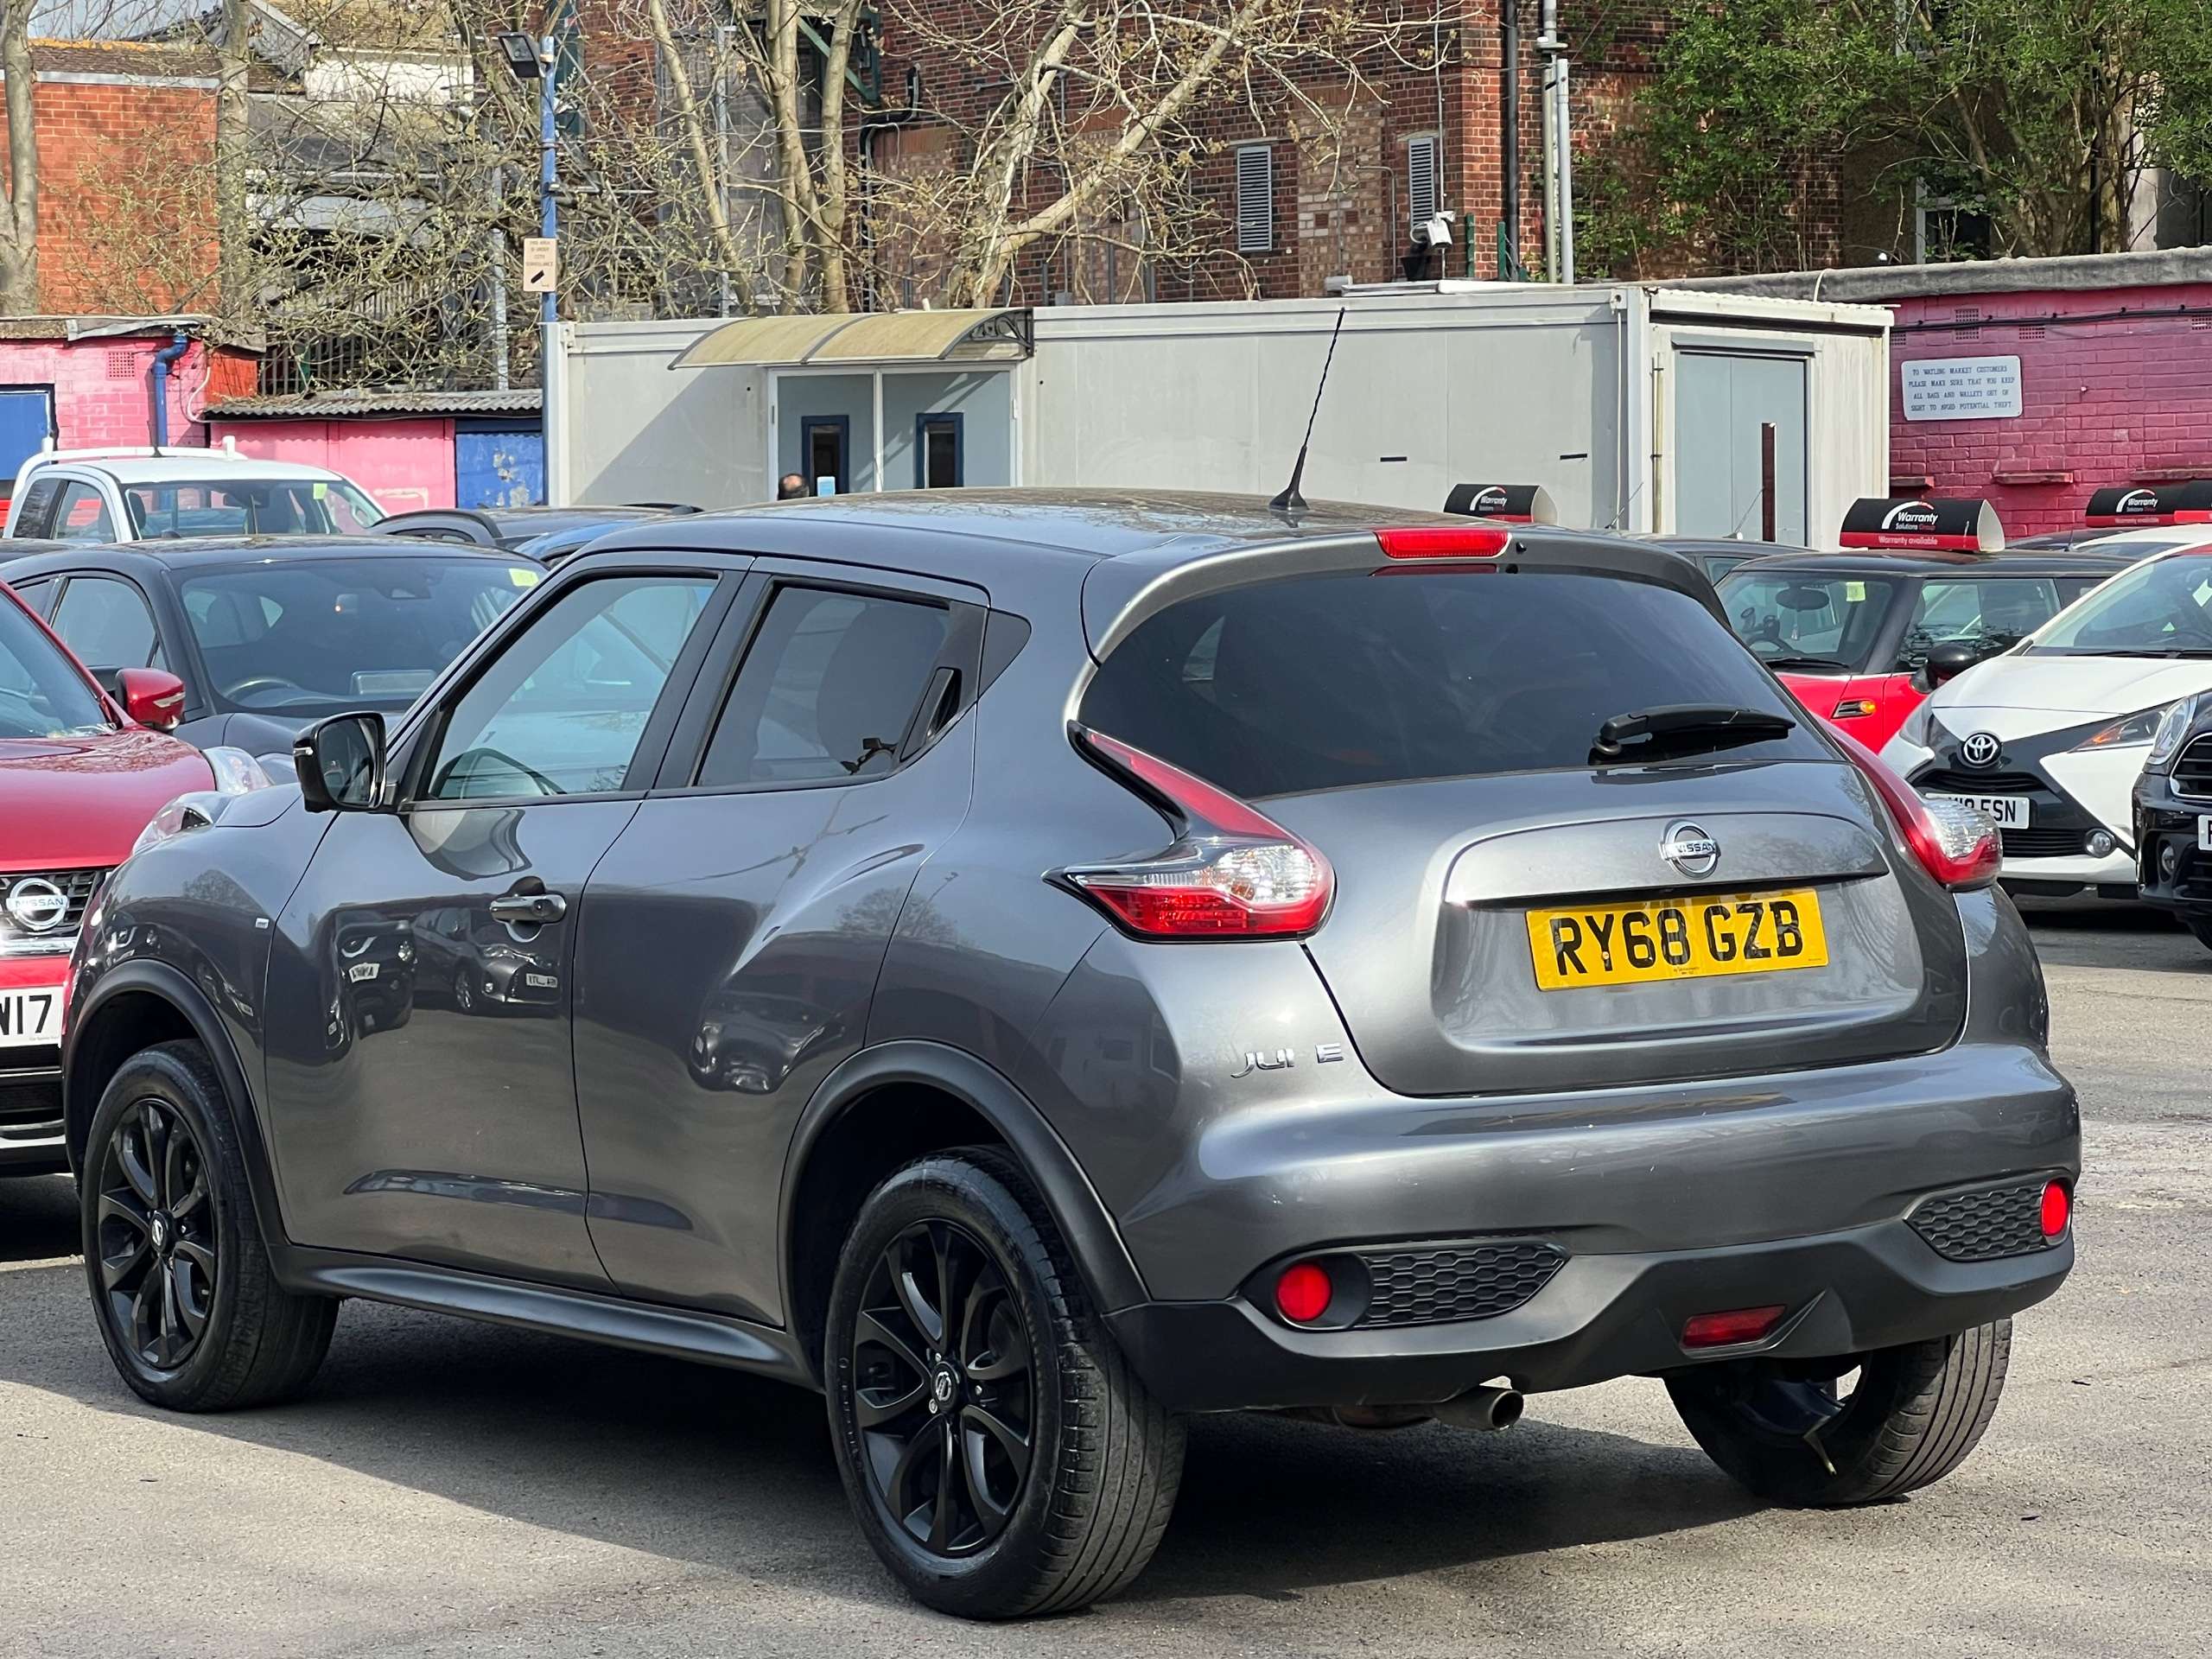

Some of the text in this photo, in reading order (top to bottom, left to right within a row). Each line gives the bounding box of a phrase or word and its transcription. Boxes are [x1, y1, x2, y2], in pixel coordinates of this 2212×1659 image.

[2127, 498, 2158, 508] Warranty
[1897, 512, 1939, 525] Warranty
[1878, 535, 1938, 545] Warranty available
[1675, 842, 1716, 854] NISSAN
[15, 898, 64, 908] NISSAN
[1549, 900, 1803, 976] RY68 GZB
